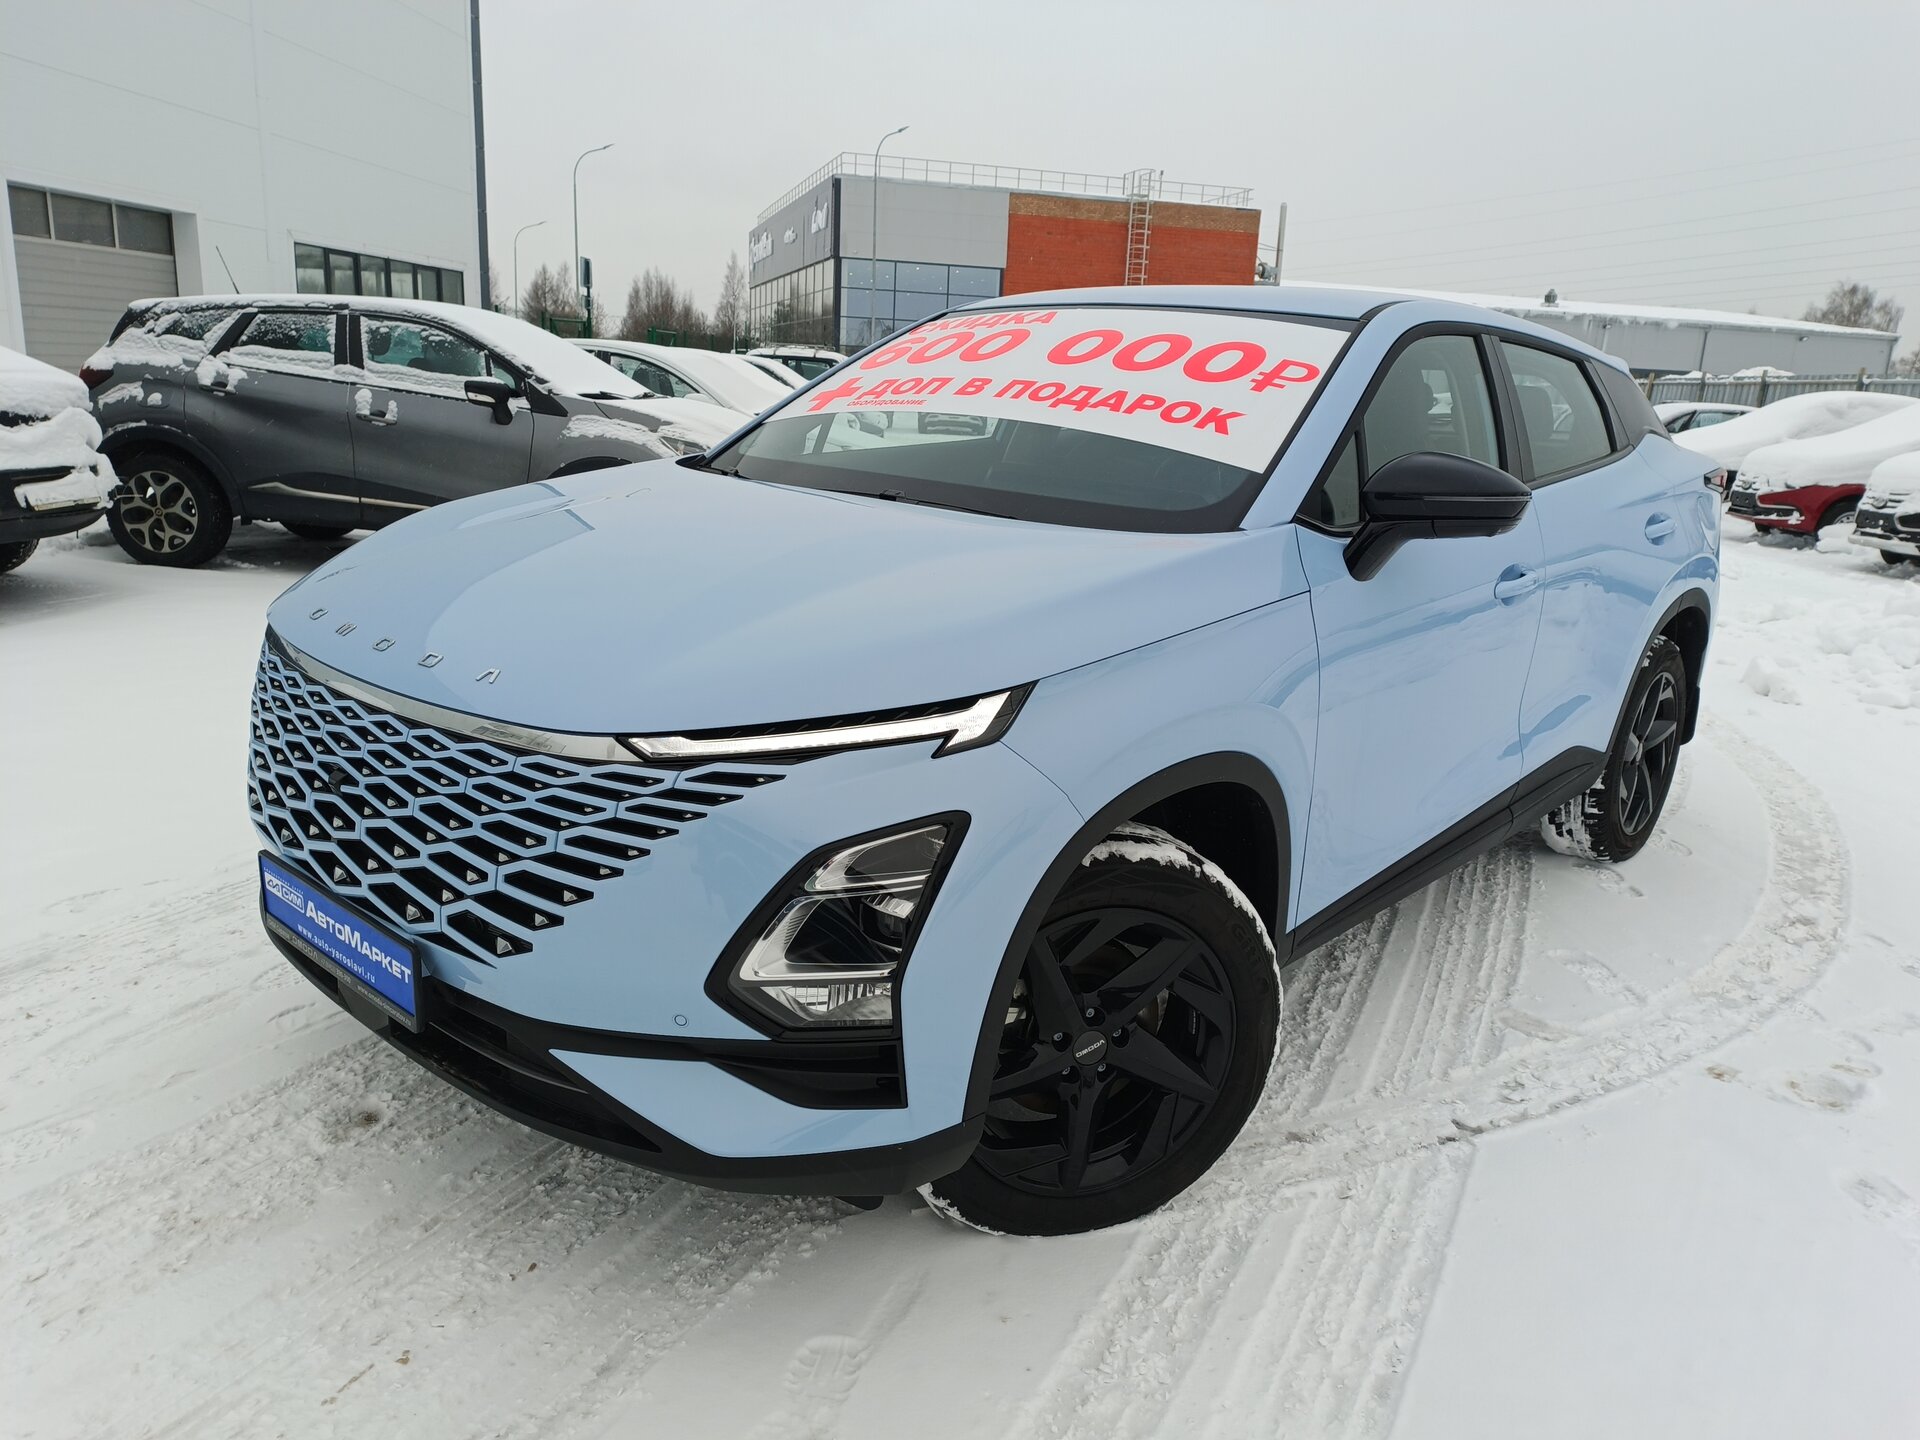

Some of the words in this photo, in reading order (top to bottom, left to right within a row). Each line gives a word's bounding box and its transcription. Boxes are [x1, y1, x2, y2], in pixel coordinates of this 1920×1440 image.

[910, 311, 1058, 335] СКИДКА
[859, 328, 1031, 370] 600
[847, 399, 928, 407] ОБОРУДОВАНИЕ
[854, 376, 955, 400] ДОП
[952, 376, 993, 396] В
[993, 378, 1251, 436] ПОДАРОК
